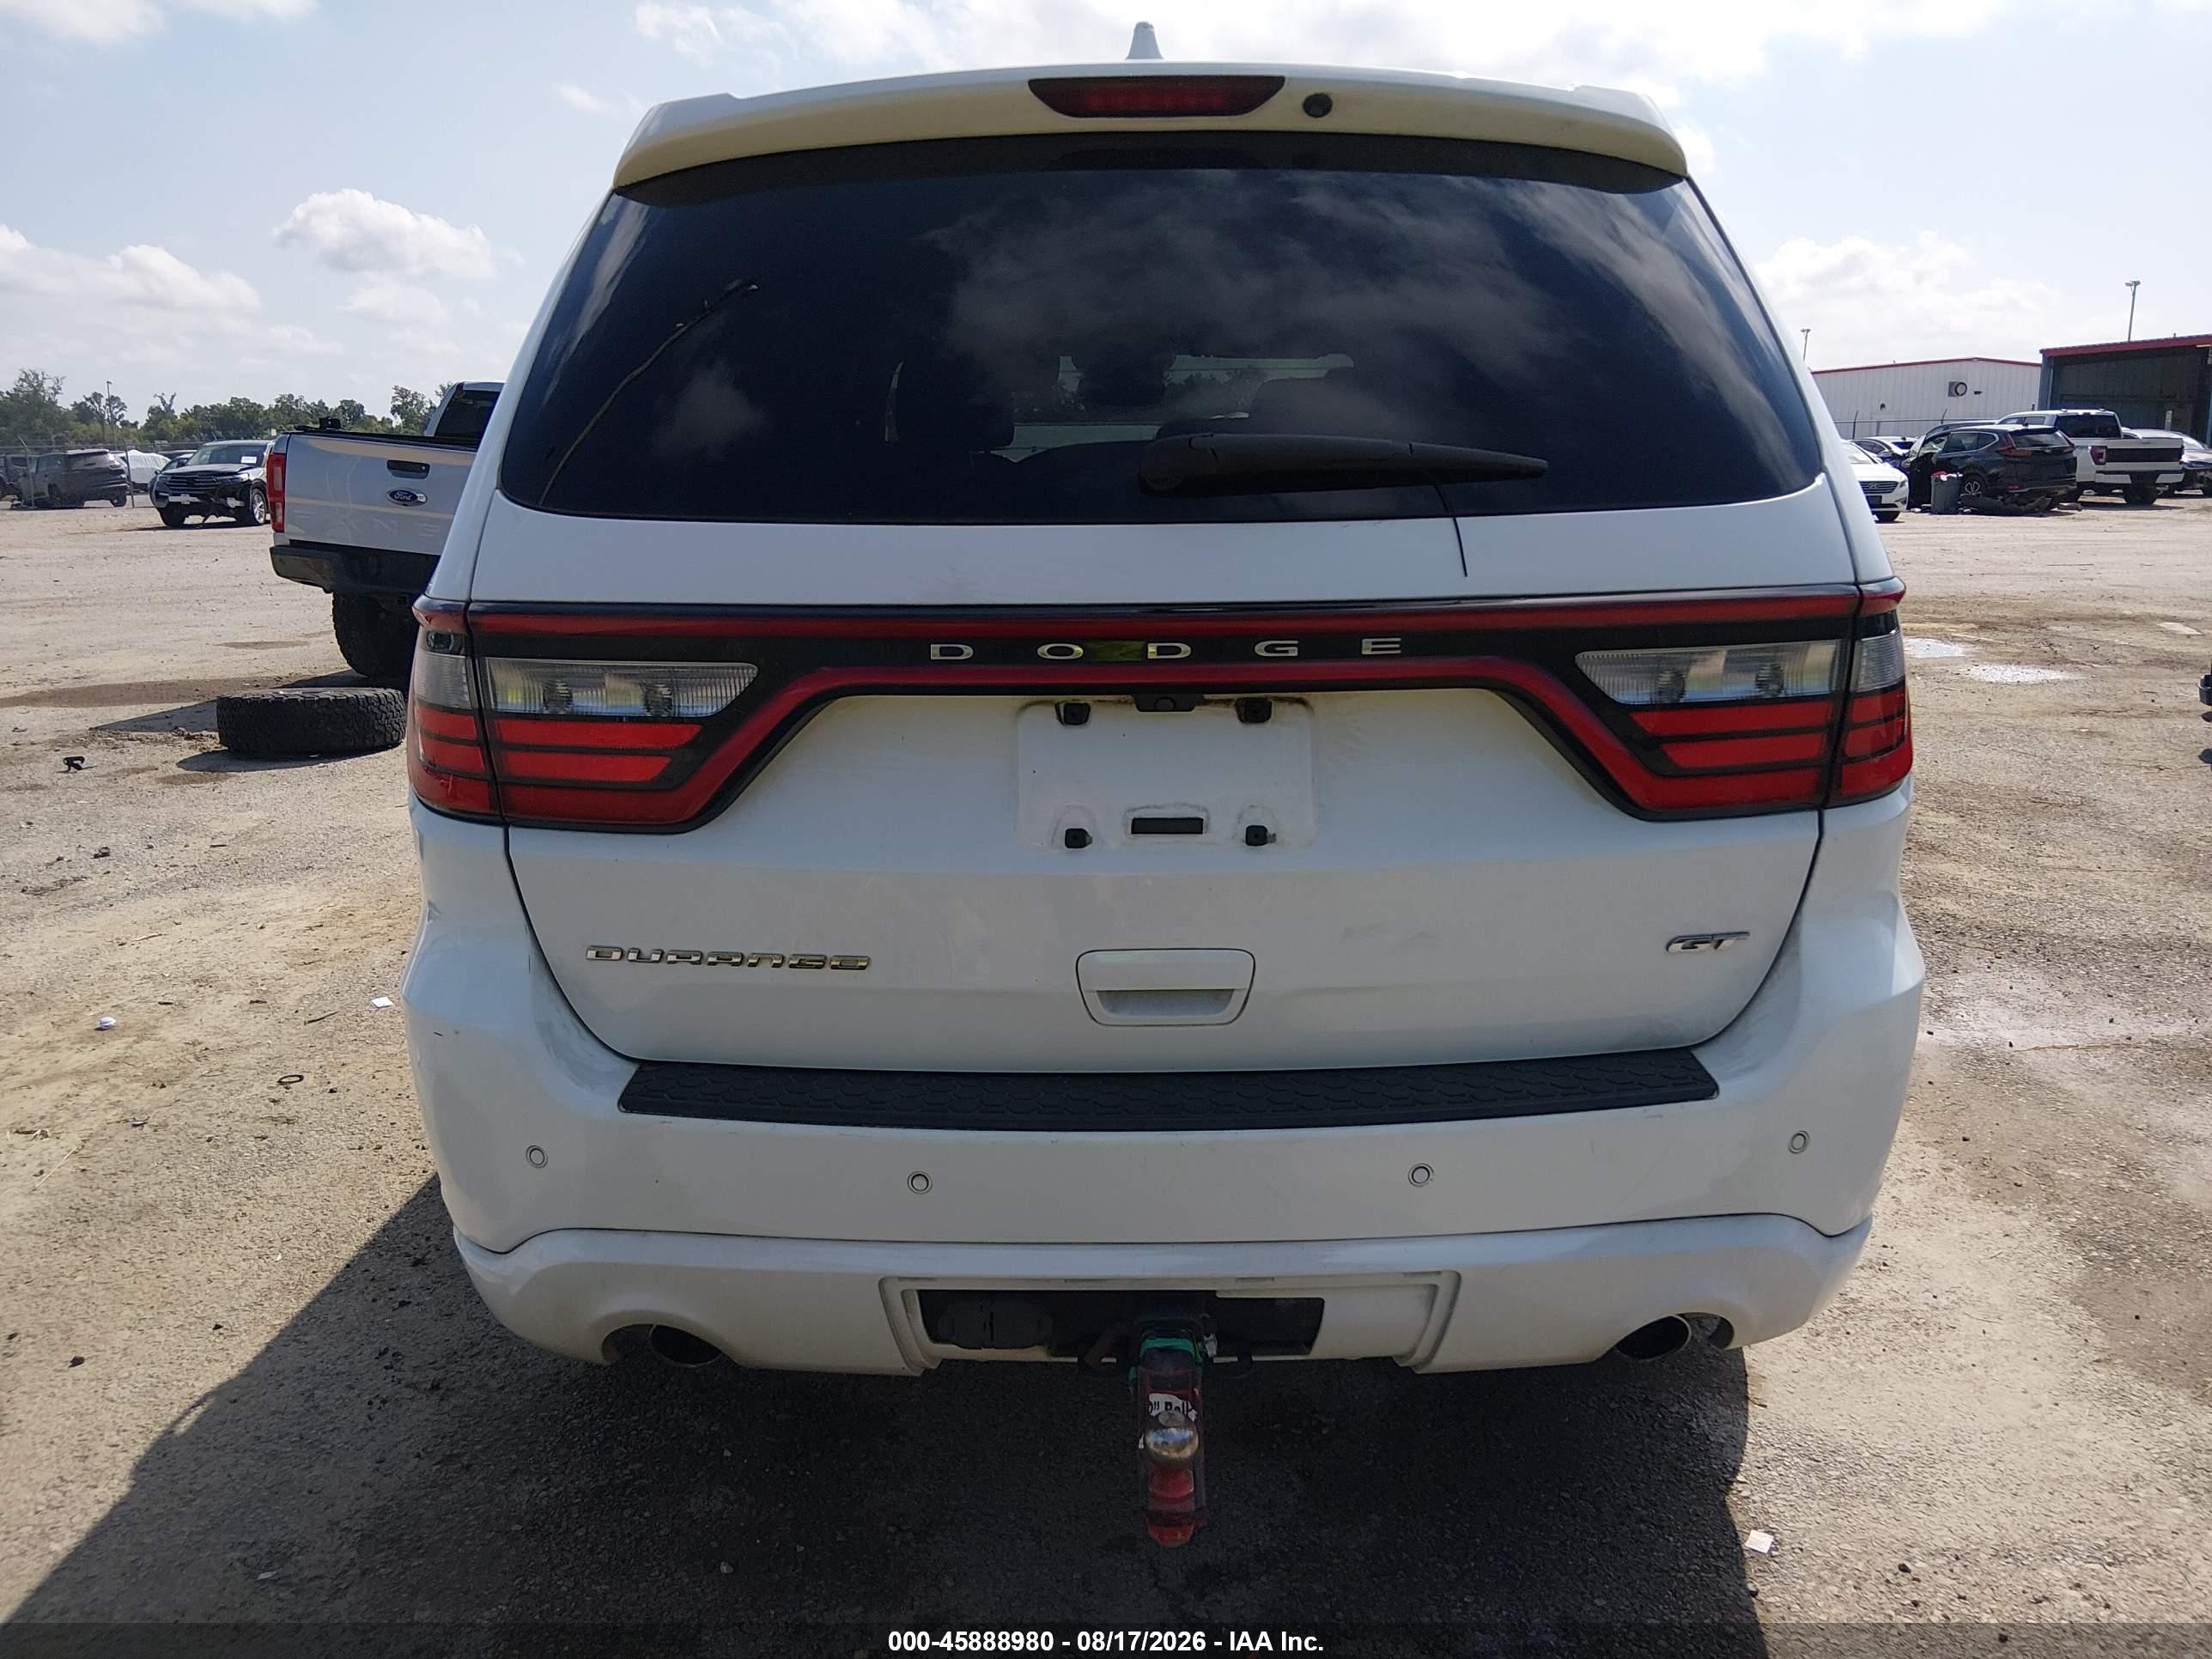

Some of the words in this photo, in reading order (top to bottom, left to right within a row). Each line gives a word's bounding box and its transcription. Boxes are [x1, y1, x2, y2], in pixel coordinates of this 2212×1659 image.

[930, 637, 1402, 661] DODGE
[1666, 931, 1751, 954] GT
[586, 945, 872, 970] DURANGO
